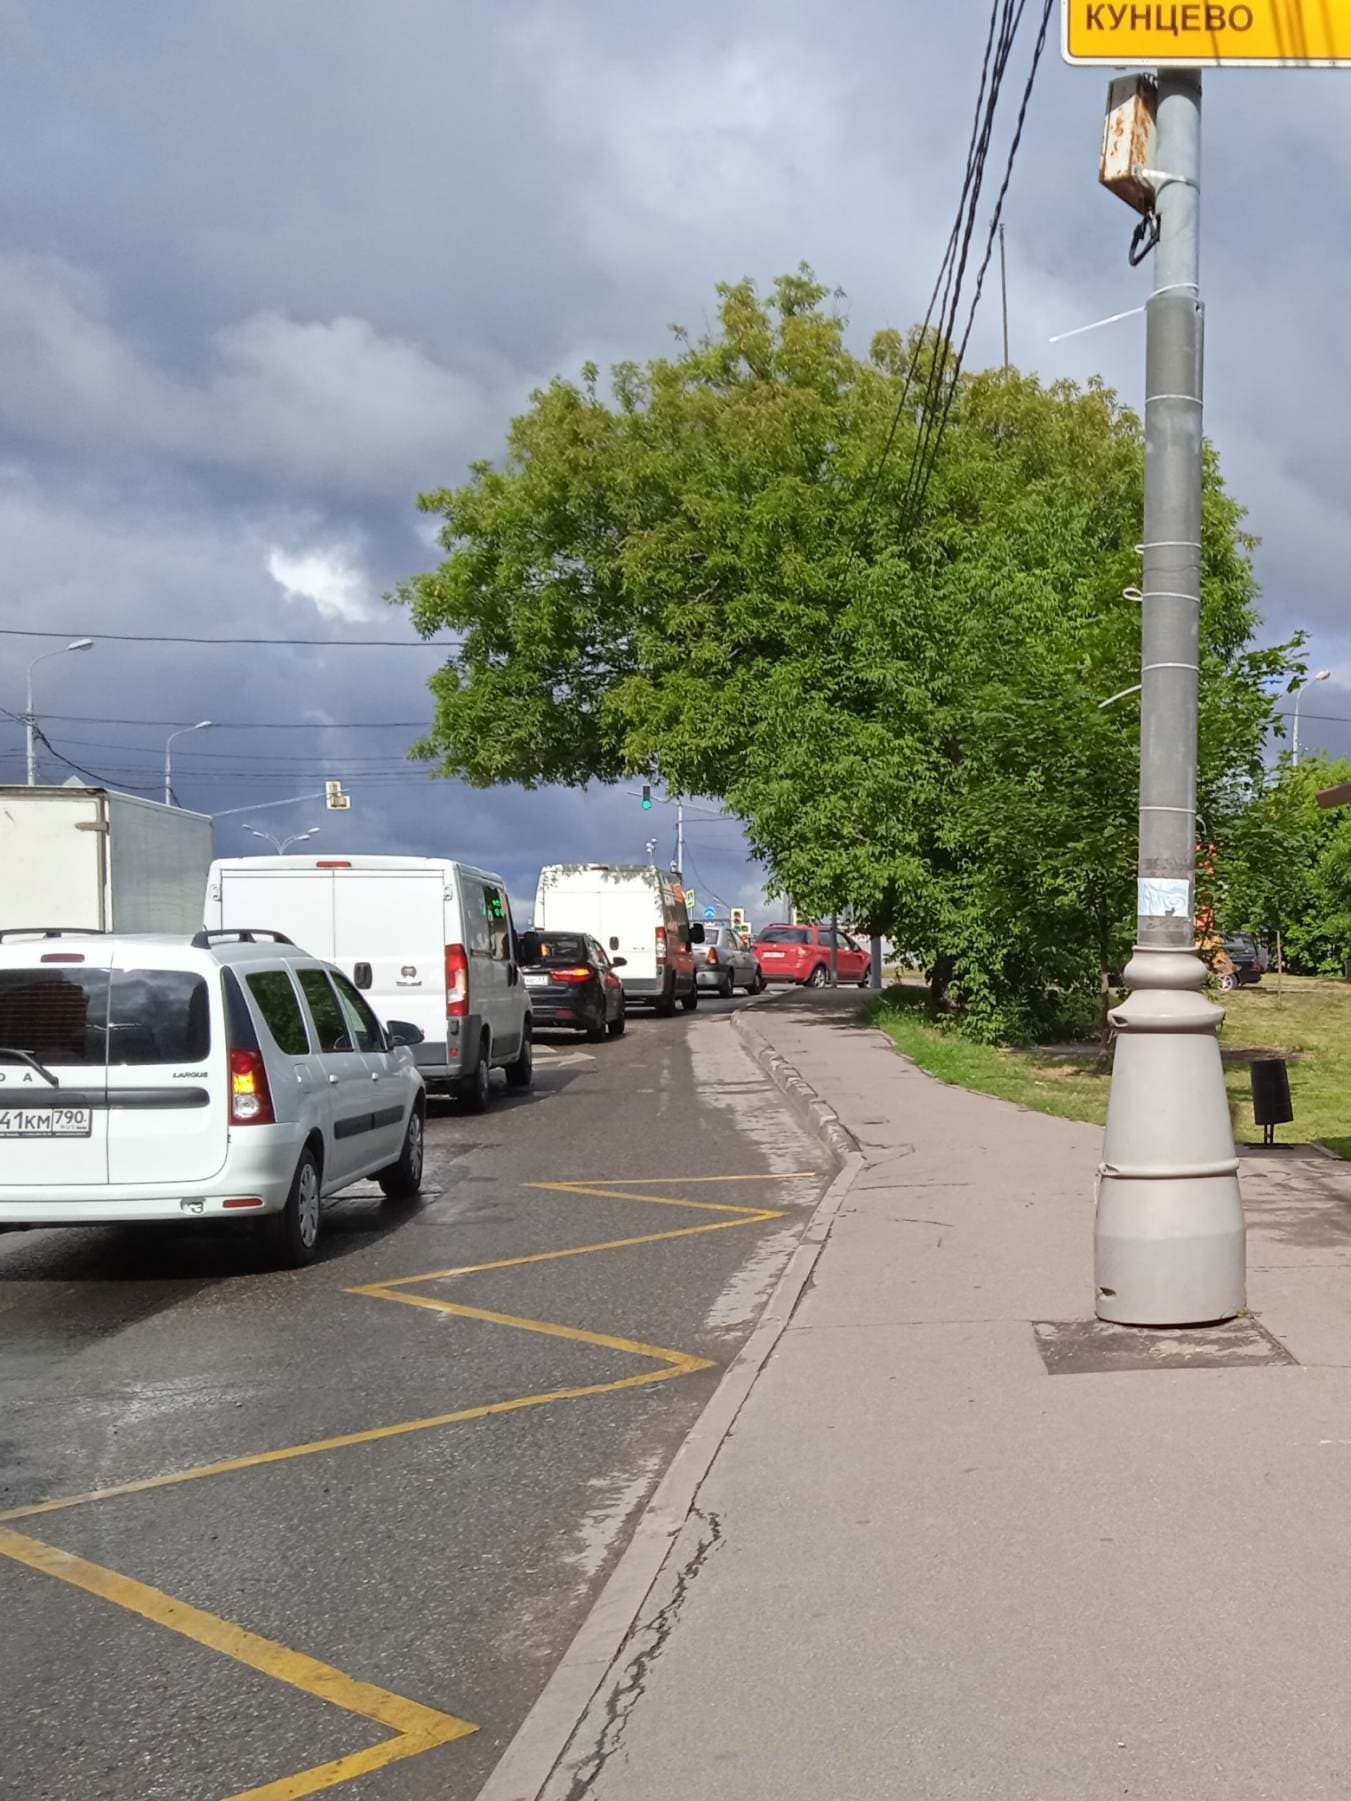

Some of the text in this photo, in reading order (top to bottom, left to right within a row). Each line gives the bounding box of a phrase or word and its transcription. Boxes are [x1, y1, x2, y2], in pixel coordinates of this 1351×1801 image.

[1086, 4, 1254, 37] КУНЦЕВО
[172, 1071, 209, 1079] LARGUS
[54, 1110, 84, 1124] 790
